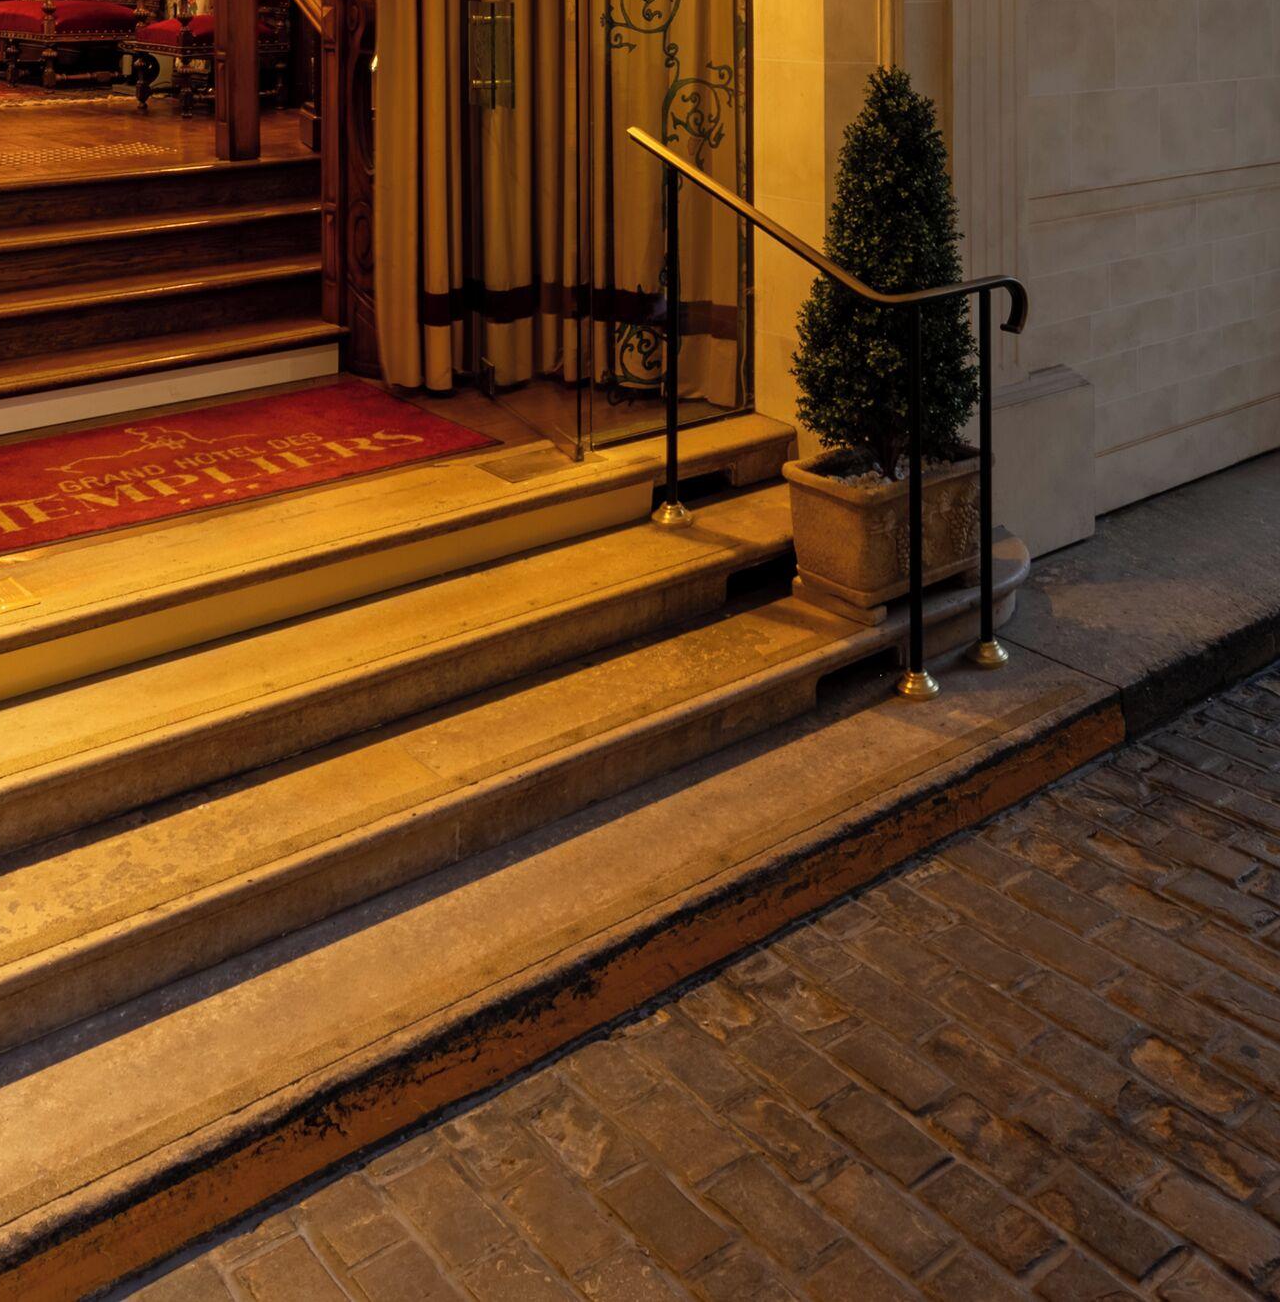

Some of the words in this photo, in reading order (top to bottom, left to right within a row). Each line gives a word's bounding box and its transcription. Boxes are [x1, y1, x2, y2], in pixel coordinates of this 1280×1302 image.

[58, 464, 165, 492] GRAND
[173, 446, 267, 469] HOTEL
[267, 432, 323, 450] DES
